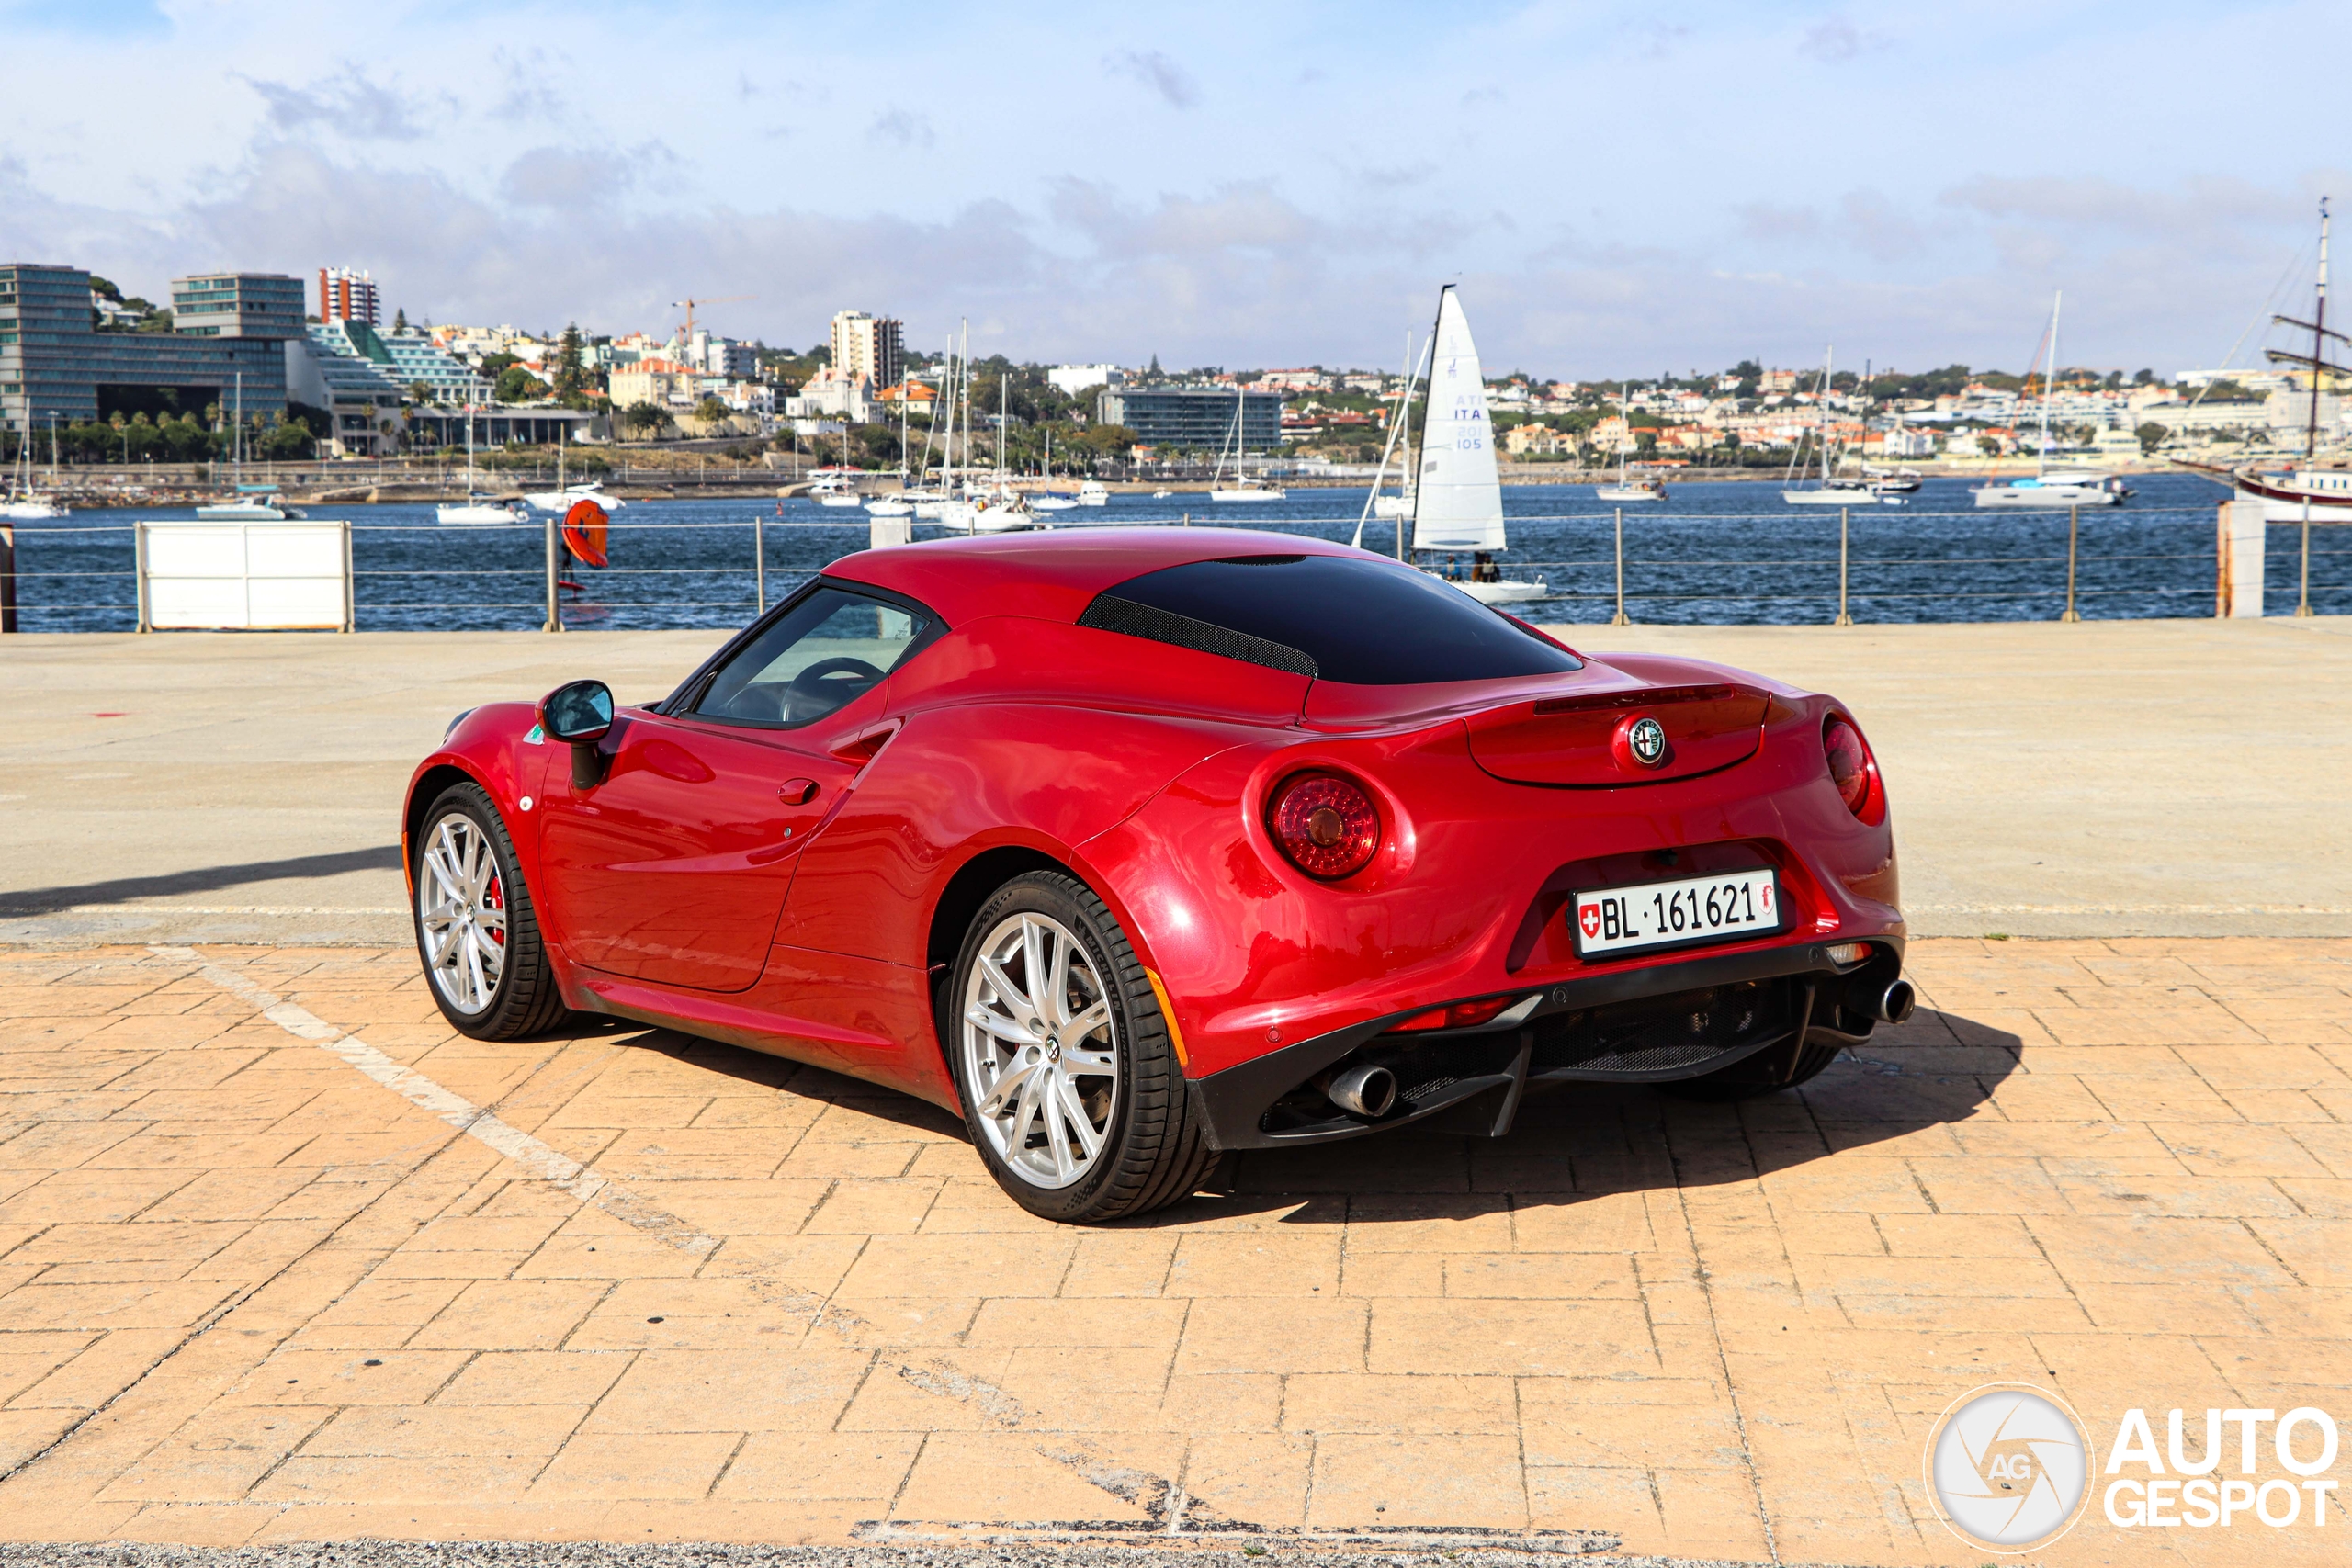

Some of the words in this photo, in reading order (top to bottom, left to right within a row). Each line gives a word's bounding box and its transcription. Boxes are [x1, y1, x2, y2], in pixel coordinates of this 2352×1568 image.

[1454, 409, 1481, 420] ITA
[1457, 438, 1482, 450] 105
[1085, 936, 1123, 1012] MICHELIN
